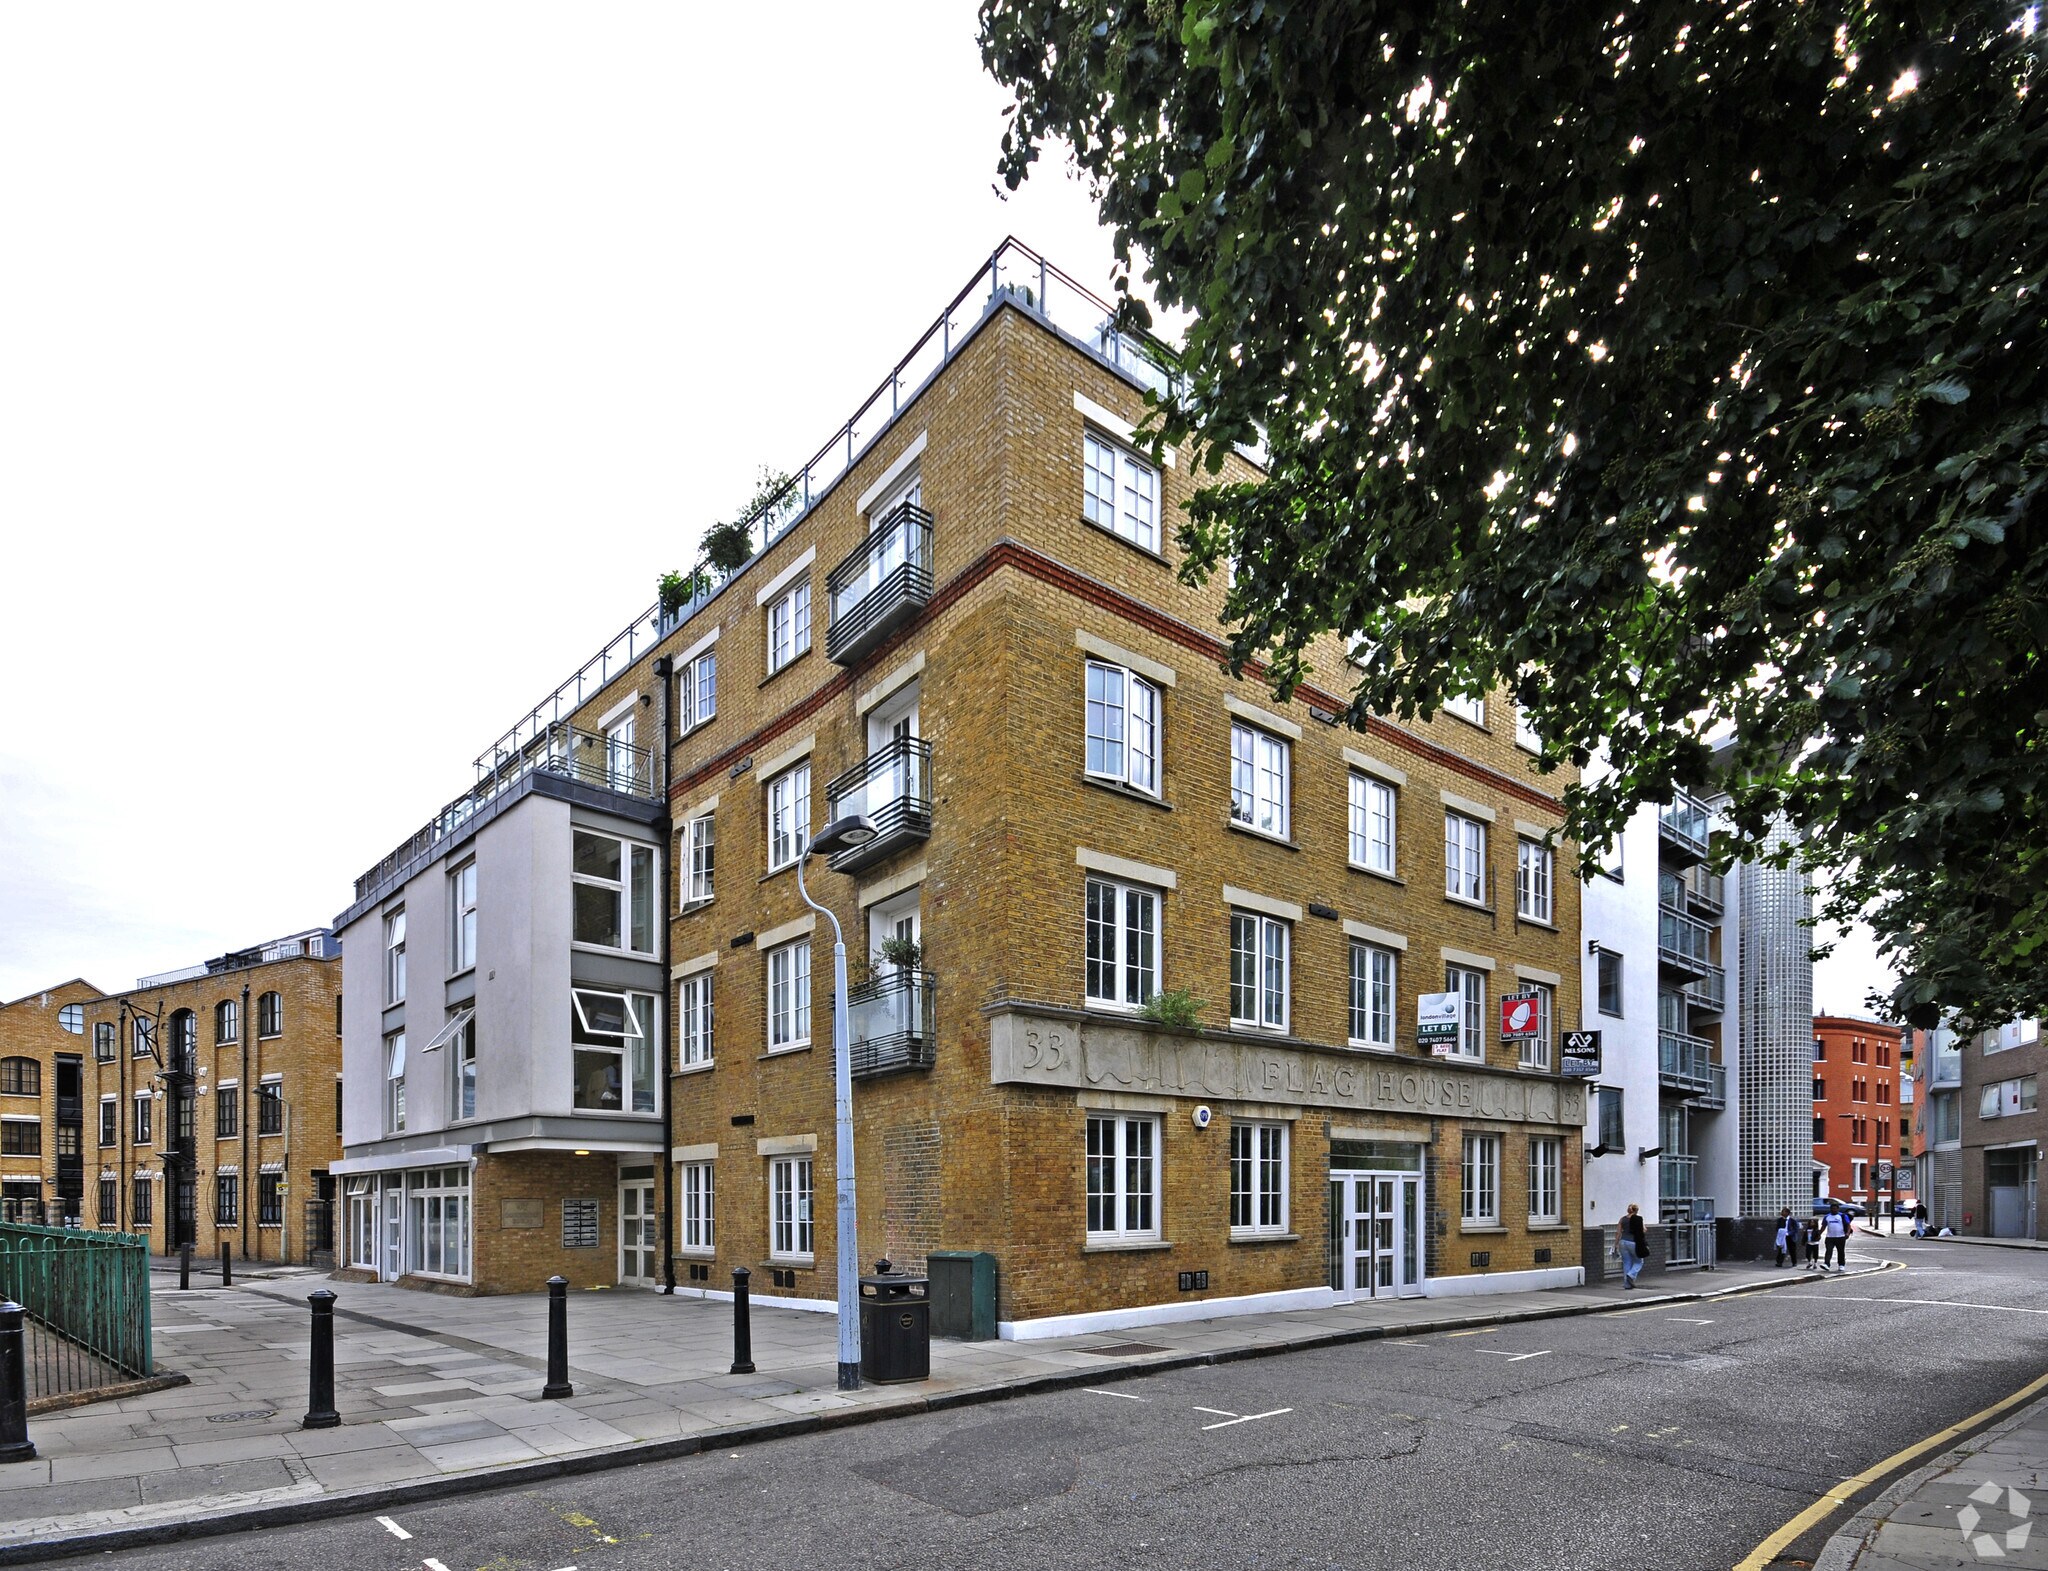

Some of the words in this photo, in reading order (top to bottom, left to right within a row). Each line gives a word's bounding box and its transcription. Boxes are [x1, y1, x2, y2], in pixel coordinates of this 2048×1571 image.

[1422, 1025, 1439, 1033] LET
[1023, 1029, 1065, 1071] 33
[1583, 1059, 1593, 1067] BY
[1262, 1059, 1355, 1098] FLAG
[1378, 1070, 1472, 1108] HOUSE
[1564, 1092, 1580, 1117] 33
